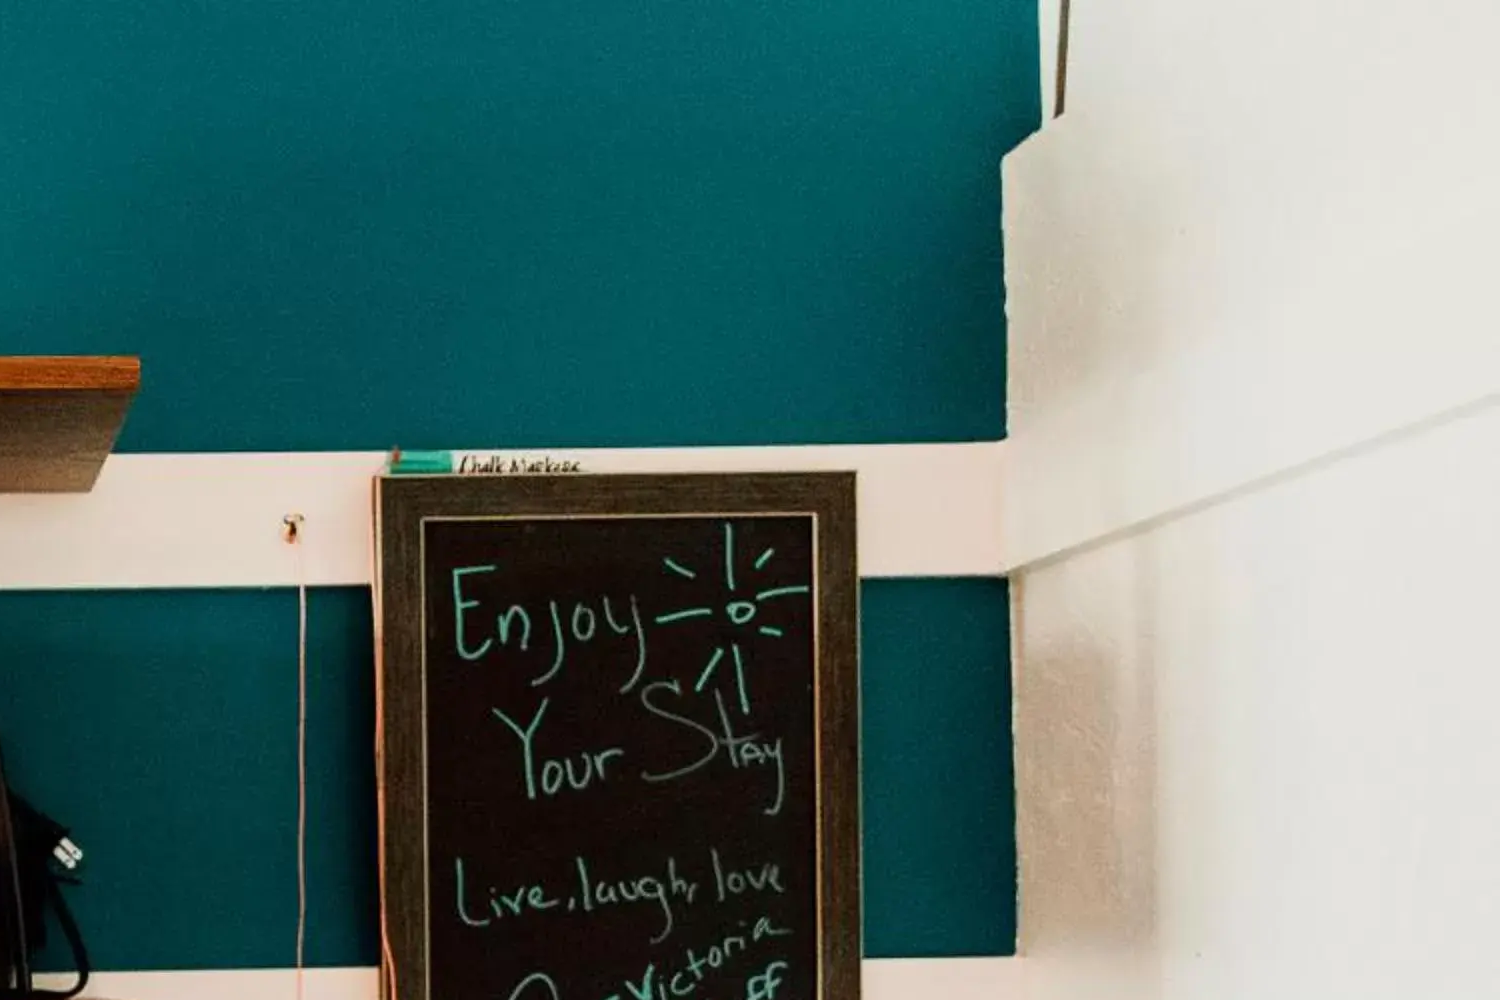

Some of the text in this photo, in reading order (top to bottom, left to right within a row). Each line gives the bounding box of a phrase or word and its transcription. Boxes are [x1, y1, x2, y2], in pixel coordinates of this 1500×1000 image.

[452, 564, 646, 694] Enjoy
[492, 680, 784, 815] Your Stay
[710, 848, 785, 901] love
